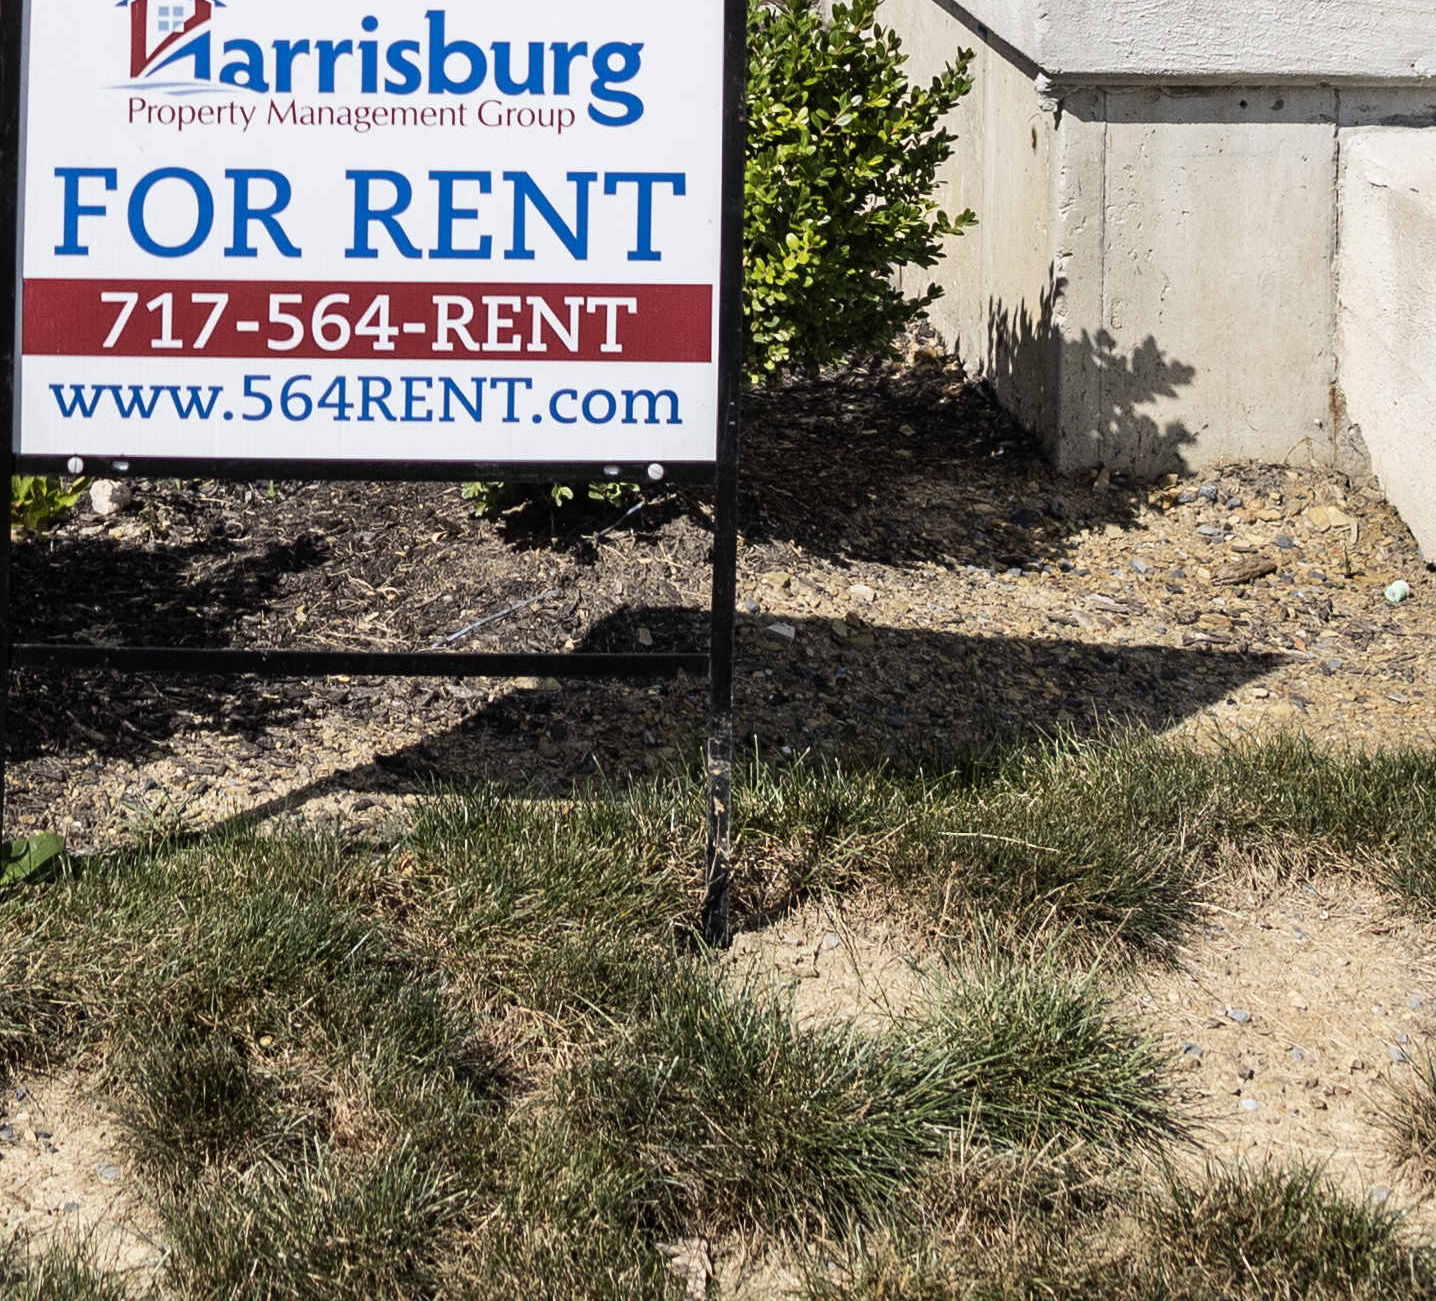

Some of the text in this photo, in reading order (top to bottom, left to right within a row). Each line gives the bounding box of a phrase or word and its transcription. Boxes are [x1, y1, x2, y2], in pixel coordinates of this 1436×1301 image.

[128, 98, 576, 135] Property Management Group
[53, 166, 687, 262] FOR RENT
[100, 290, 638, 354] 717-564-RENT
[48, 374, 683, 425] www.564RENT.com
